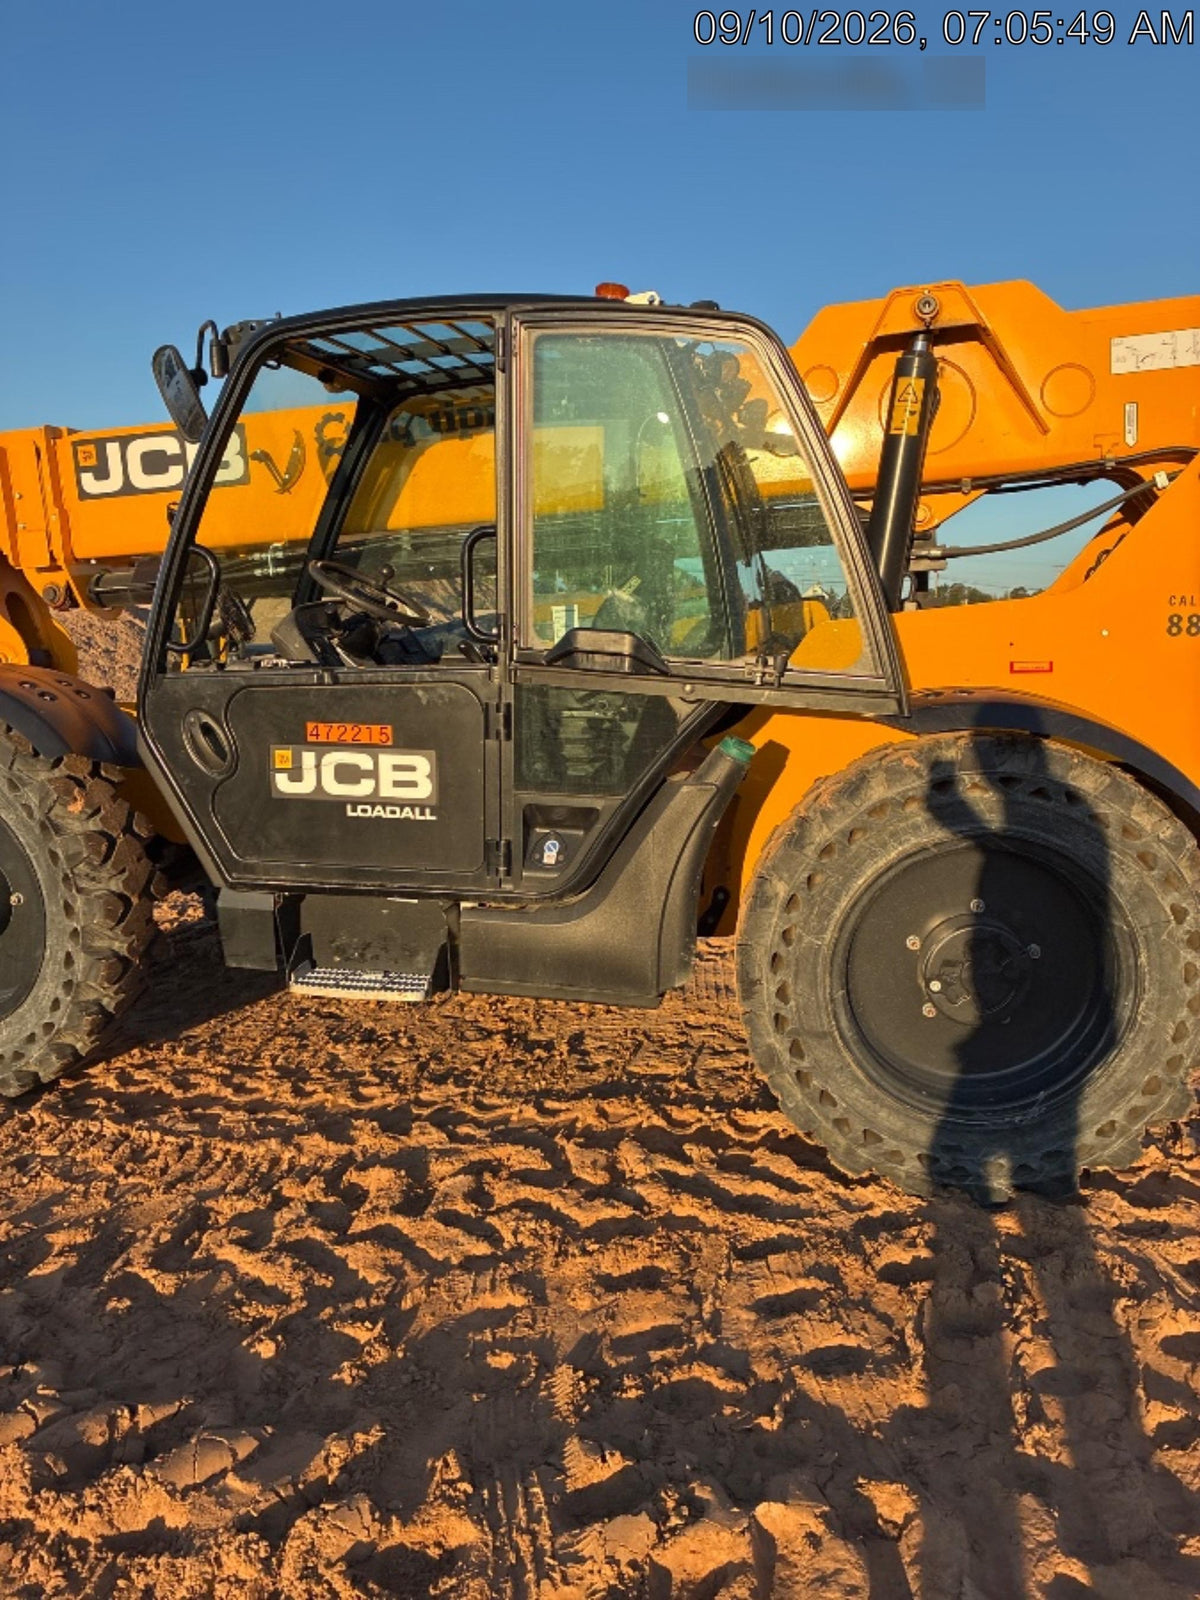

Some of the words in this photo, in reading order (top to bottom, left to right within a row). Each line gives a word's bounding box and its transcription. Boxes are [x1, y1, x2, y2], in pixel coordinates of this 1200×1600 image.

[80, 431, 244, 495] JCB
[309, 725, 391, 744] 472215
[275, 751, 433, 799] JCB
[346, 803, 437, 821] LOADALL
